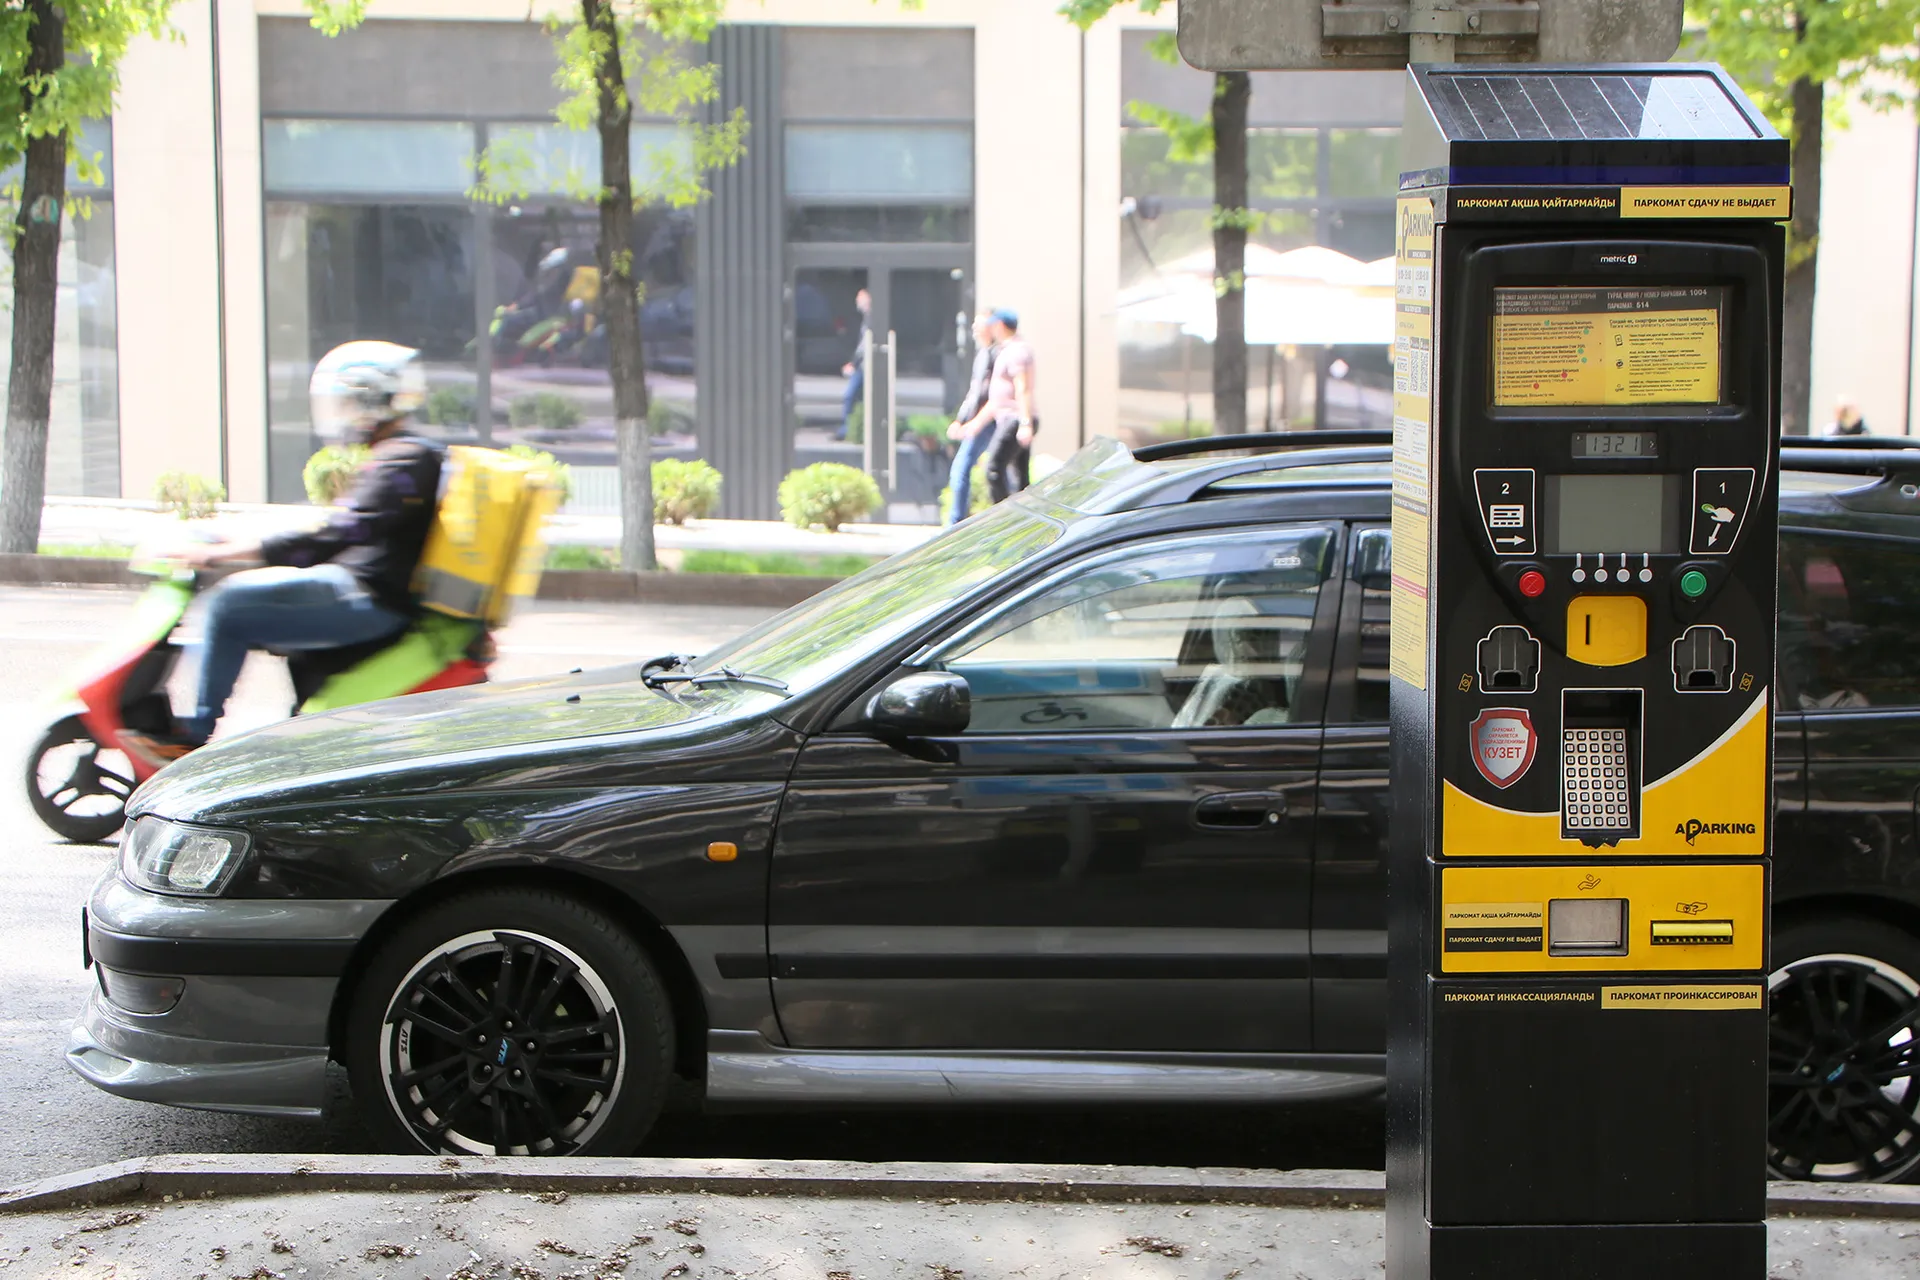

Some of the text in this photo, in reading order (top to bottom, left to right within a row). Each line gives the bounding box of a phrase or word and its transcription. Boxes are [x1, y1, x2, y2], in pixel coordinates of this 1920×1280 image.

[1457, 197, 1616, 208] ПАРКОМАТ АҚША ҚАЙТАРМАЙДЫ
[1634, 199, 1777, 208] ПАРКОМАТ СДАЧУ НЕ ВЫДАЕТ
[1502, 482, 1510, 495] 2
[1719, 482, 1726, 494] 1
[1484, 746, 1522, 759] КУЗЕТ
[1516, 935, 1542, 943] ВЫДАЕТ
[1444, 993, 1595, 1002] ПАРКОМАТ ИНКАССАЦИЯЛАНДЫ
[1610, 991, 1758, 1000] ПАРКОМАТ ПРОИНКАССИРОВАН
